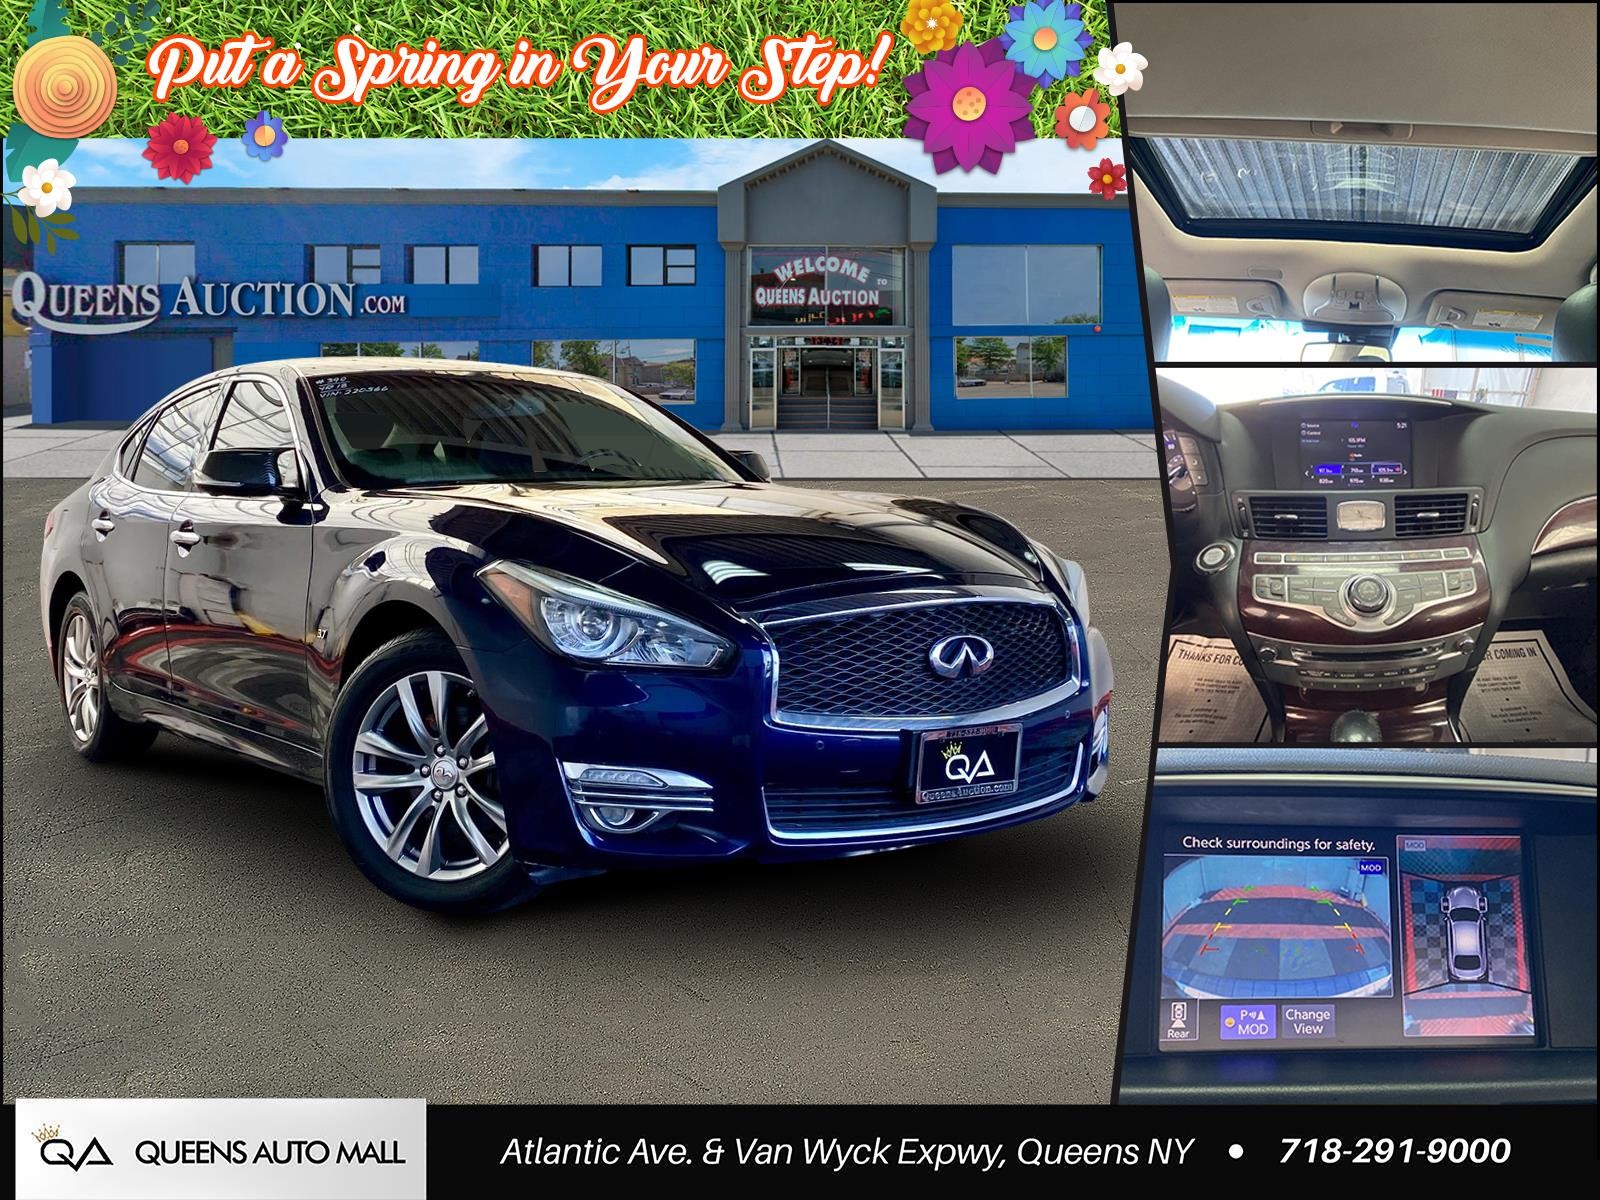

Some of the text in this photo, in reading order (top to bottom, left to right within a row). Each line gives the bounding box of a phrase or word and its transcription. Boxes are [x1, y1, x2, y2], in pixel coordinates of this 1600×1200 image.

[773, 256, 871, 284] WELCOME
[11, 271, 161, 335] QUEENS
[755, 287, 879, 306] QUEENS AUCTION
[1179, 649, 1213, 664] THANKS
[1213, 653, 1231, 665] FOR
[1494, 647, 1526, 660] COMING
[1527, 647, 1538, 657] IN
[1183, 836, 1376, 853] Check surroundings for safety.
[1360, 863, 1382, 872] MOD
[1285, 1009, 1331, 1022] Change
[1167, 1028, 1190, 1039] Rear
[1238, 1024, 1269, 1035] MOD
[1293, 1023, 1324, 1035] View
